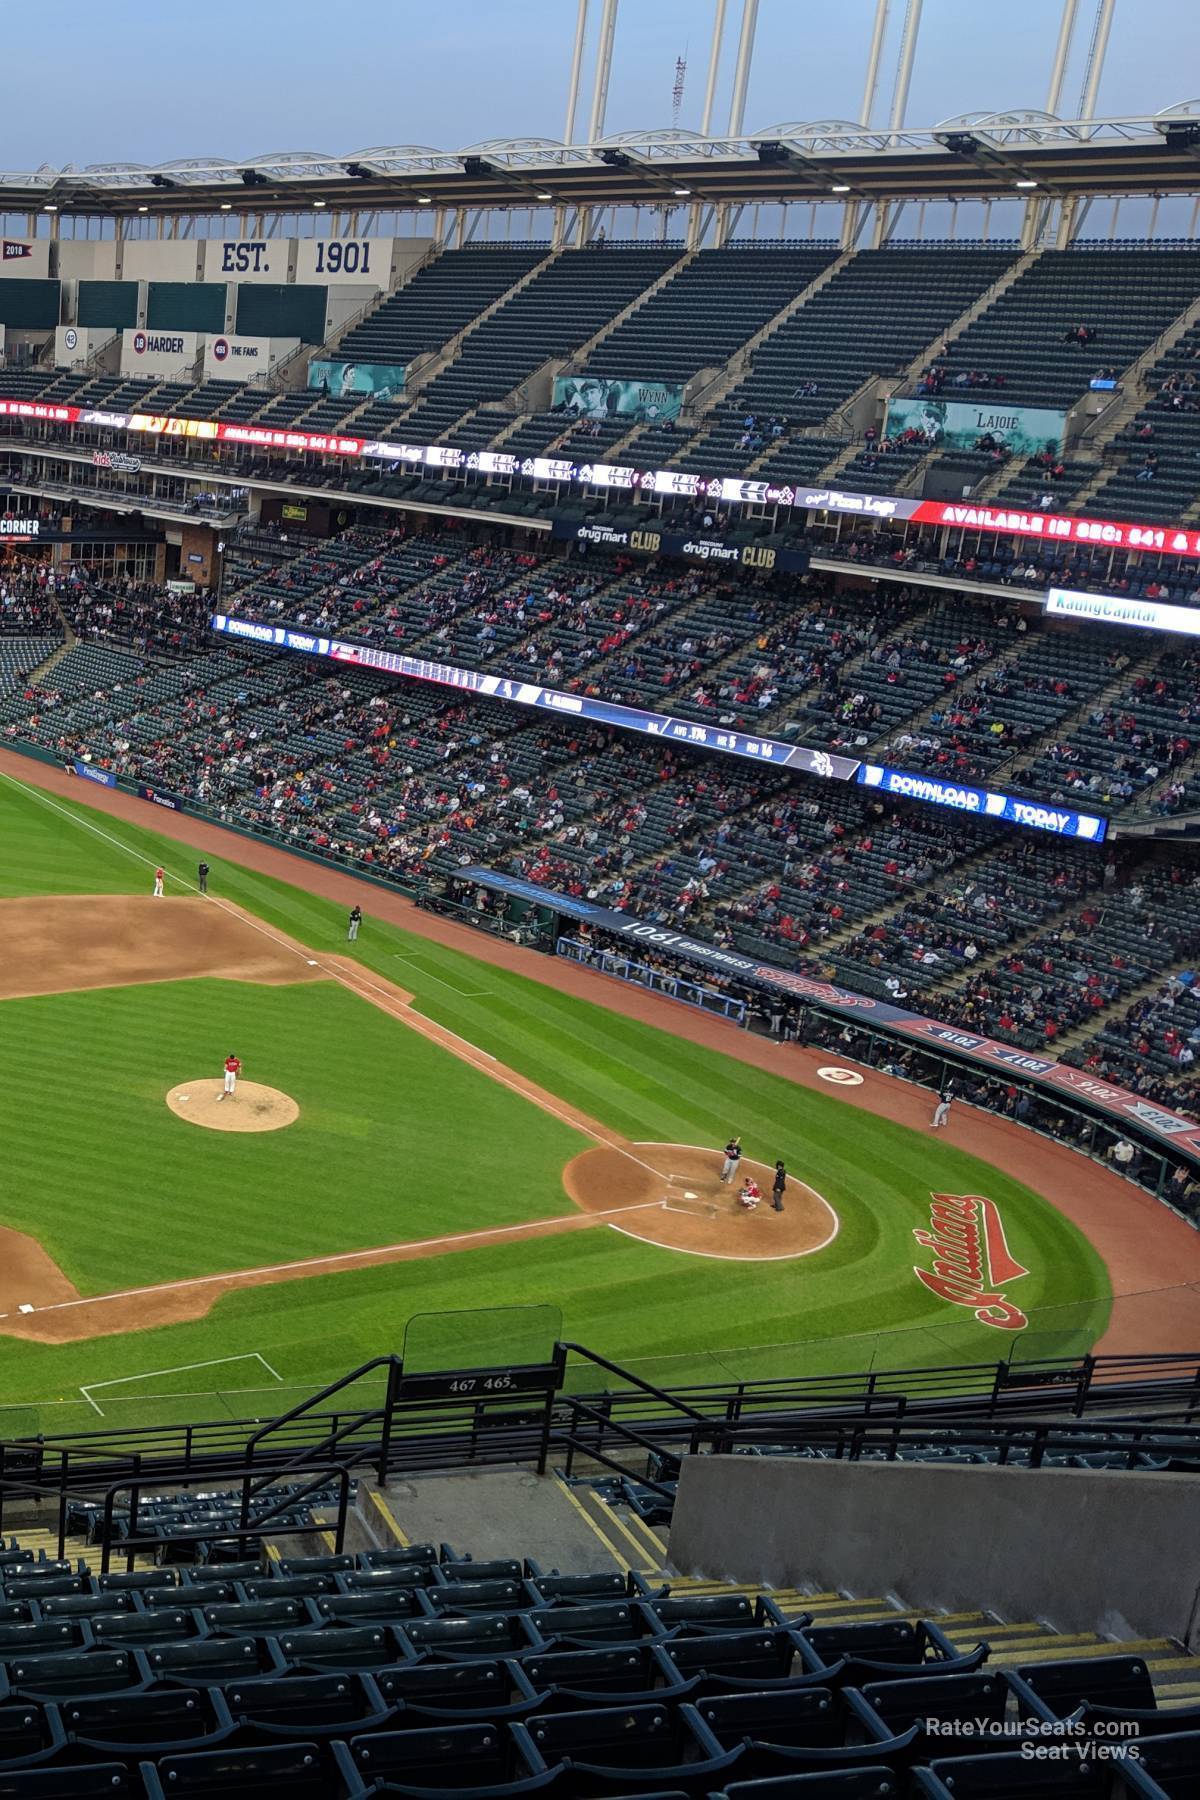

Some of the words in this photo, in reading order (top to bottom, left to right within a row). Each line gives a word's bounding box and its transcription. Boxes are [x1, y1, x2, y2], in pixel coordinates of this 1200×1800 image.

[6, 245, 23, 256] 2018
[222, 242, 269, 272] EST.
[315, 241, 370, 273] 1901
[66, 334, 76, 345] 42
[135, 337, 145, 349] 18
[147, 336, 184, 353] HARDER
[231, 345, 244, 357] THE
[245, 346, 258, 357] FANS
[225, 428, 273, 443] AVAILABLE
[93, 452, 110, 466] kids
[829, 492, 863, 510] Pizza
[865, 497, 896, 516] Logs
[0, 520, 39, 534] CORNER
[942, 507, 1044, 533] AVAILABLE
[1048, 517, 1072, 536] IN
[1076, 522, 1122, 543] SEC:
[1128, 530, 1165, 548] 541
[1172, 534, 1188, 550] &
[578, 526, 601, 543] drug
[603, 531, 628, 543] mart
[630, 530, 661, 552] CLUB
[683, 541, 709, 558] drug
[710, 546, 739, 560] mart
[741, 546, 776, 569] CLUB
[228, 620, 273, 640] DOWNLOAD
[288, 633, 316, 649] TODAY
[890, 774, 980, 807] DOWNLOAD
[1014, 803, 1070, 829] TODAY
[621, 922, 682, 946] 1901
[678, 942, 752, 970] ESTABLISHED
[938, 1031, 976, 1047] 2018
[1004, 1055, 1042, 1072] 2017
[1076, 1081, 1117, 1100] 2016
[1141, 1111, 1183, 1129] 2013
[912, 1192, 1031, 1330] Indians
[450, 1380, 476, 1392] 467
[484, 1377, 511, 1389] 465
